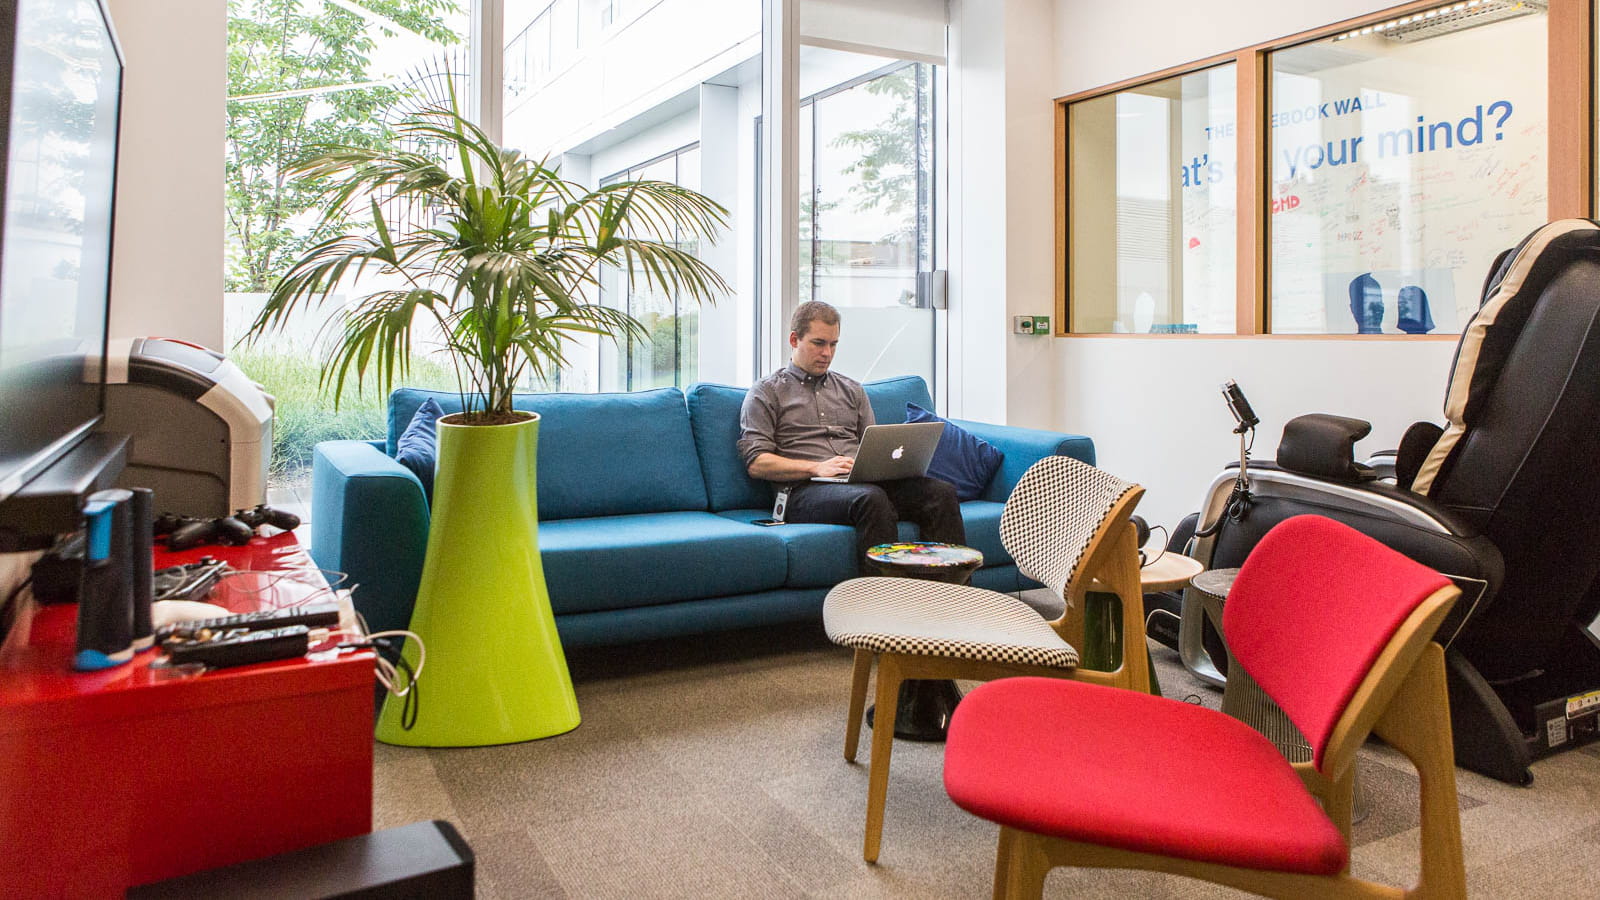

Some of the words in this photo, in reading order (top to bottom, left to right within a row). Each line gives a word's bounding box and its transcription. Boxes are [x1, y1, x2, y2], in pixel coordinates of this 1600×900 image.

[1182, 154, 1223, 187] at's
[1283, 136, 1364, 181] your
[1378, 101, 1513, 158] mind?
[1205, 123, 1234, 141] THE
[1272, 103, 1329, 128] EBOOK
[1334, 93, 1386, 116] WALL
